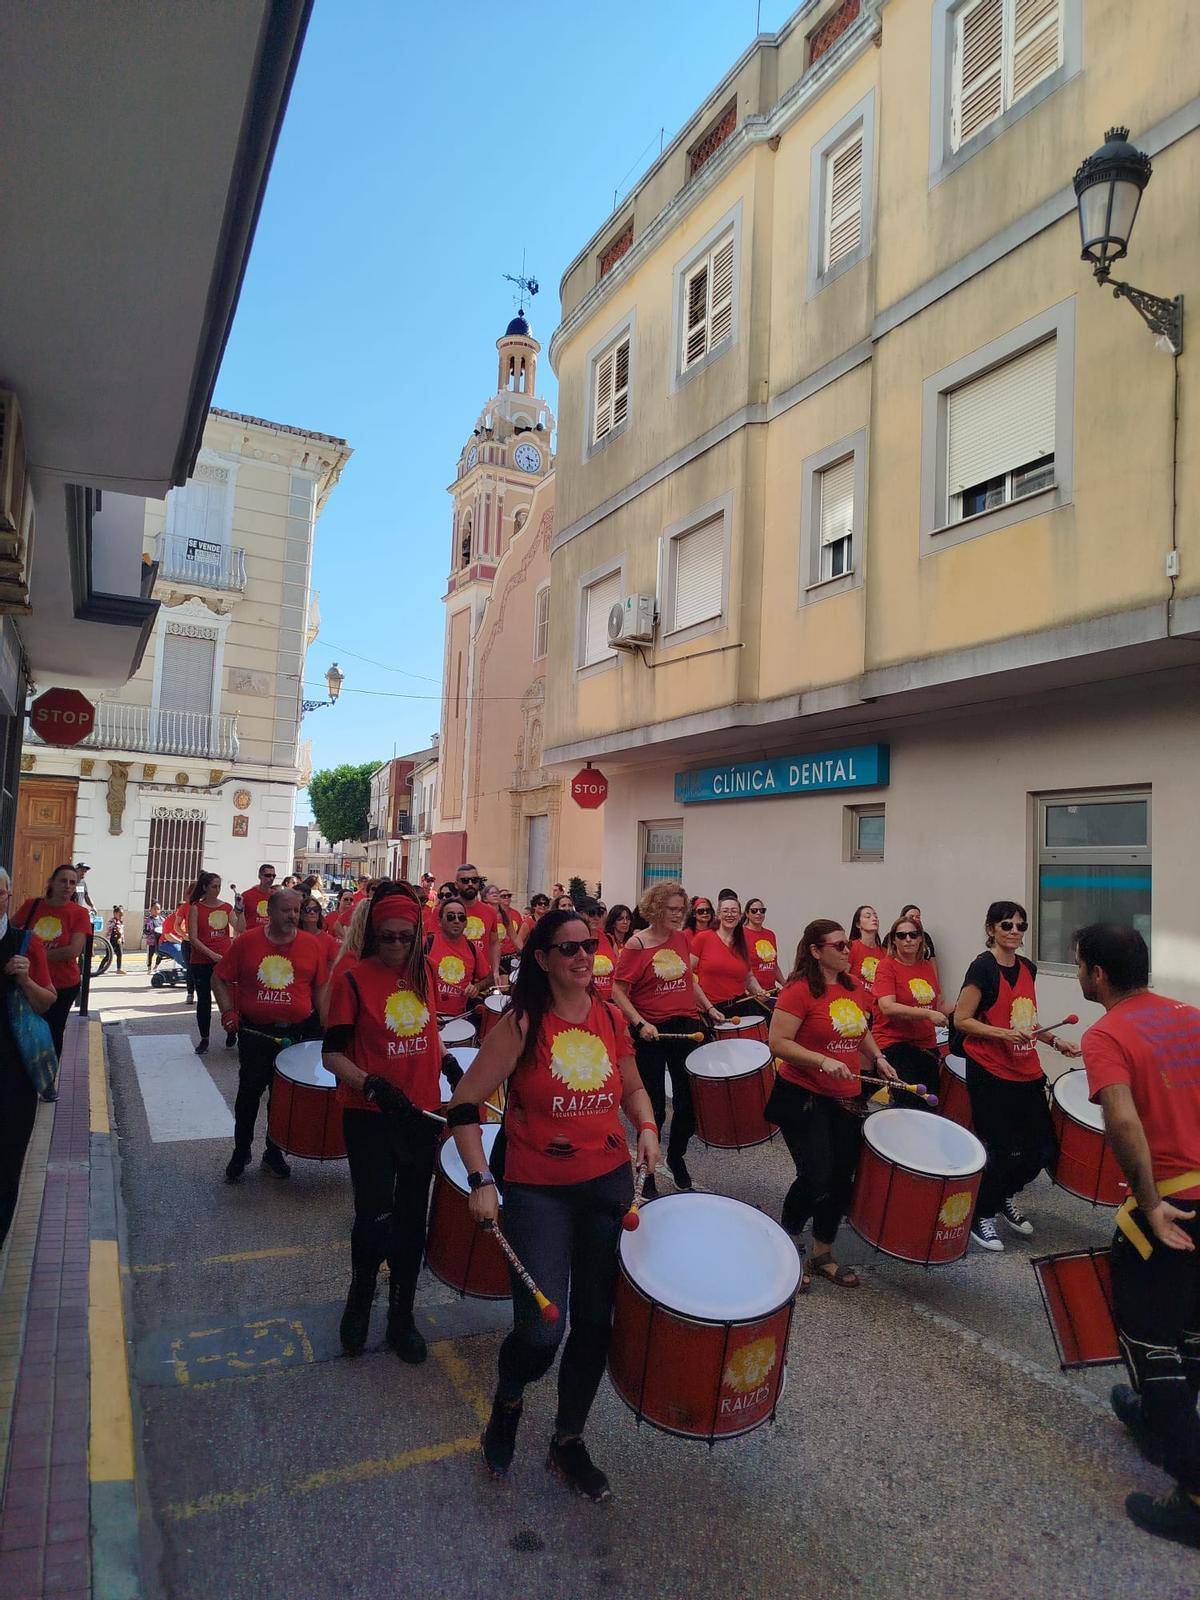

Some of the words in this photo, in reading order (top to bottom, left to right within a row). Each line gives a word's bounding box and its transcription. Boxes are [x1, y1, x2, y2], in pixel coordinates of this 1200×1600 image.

[189, 539, 198, 548] SE
[198, 541, 221, 553] VENDE
[37, 708, 90, 725] STOP
[713, 767, 775, 794] CLÍNICA
[789, 757, 857, 786] DENTAL
[574, 783, 606, 794] STOP
[656, 979, 687, 992] RAIZES
[257, 990, 292, 1003] RAIZES
[388, 1035, 428, 1056] RAIZES
[552, 1092, 614, 1112] RAIZES
[720, 1382, 770, 1414] RAIZES
